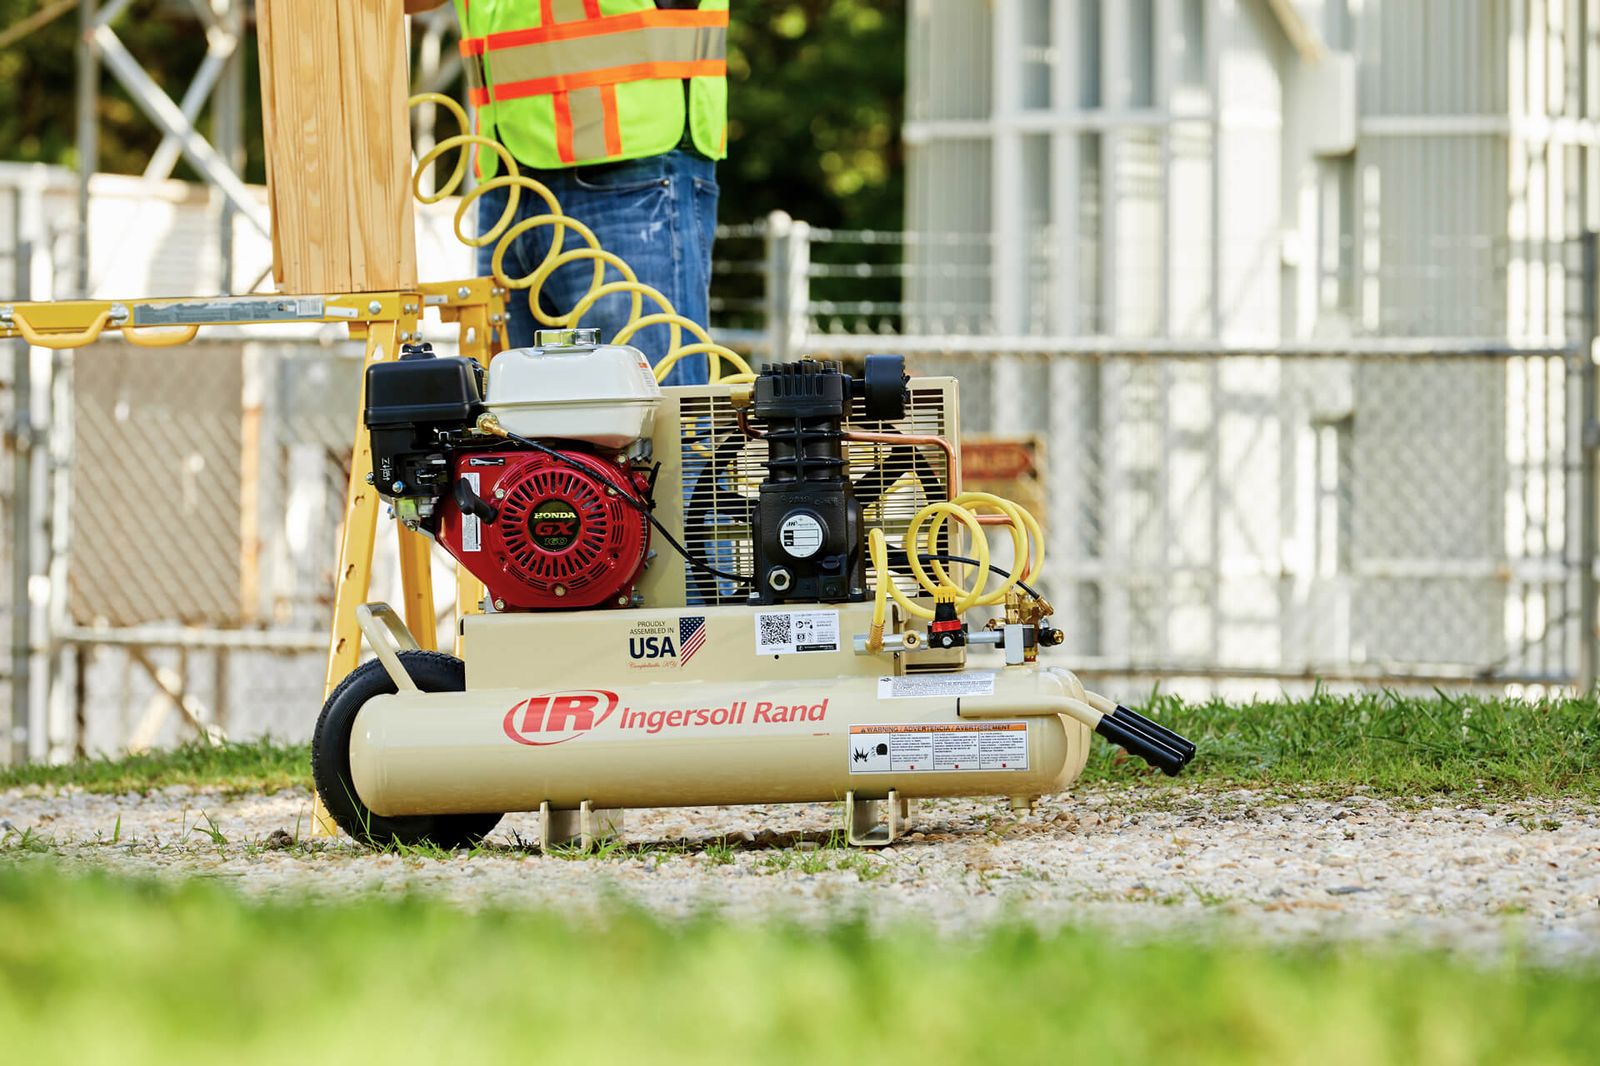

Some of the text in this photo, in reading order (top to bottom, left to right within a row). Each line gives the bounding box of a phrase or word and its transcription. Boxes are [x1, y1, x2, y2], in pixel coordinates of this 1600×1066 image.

[535, 522, 576, 536] GX
[637, 620, 666, 628] PROUDLY
[630, 627, 667, 635] ASSEMBLED
[629, 636, 677, 659] USA
[619, 701, 747, 734] Ingersoll
[752, 698, 830, 724] Rand
[903, 725, 951, 733] ADVERTENCIA
